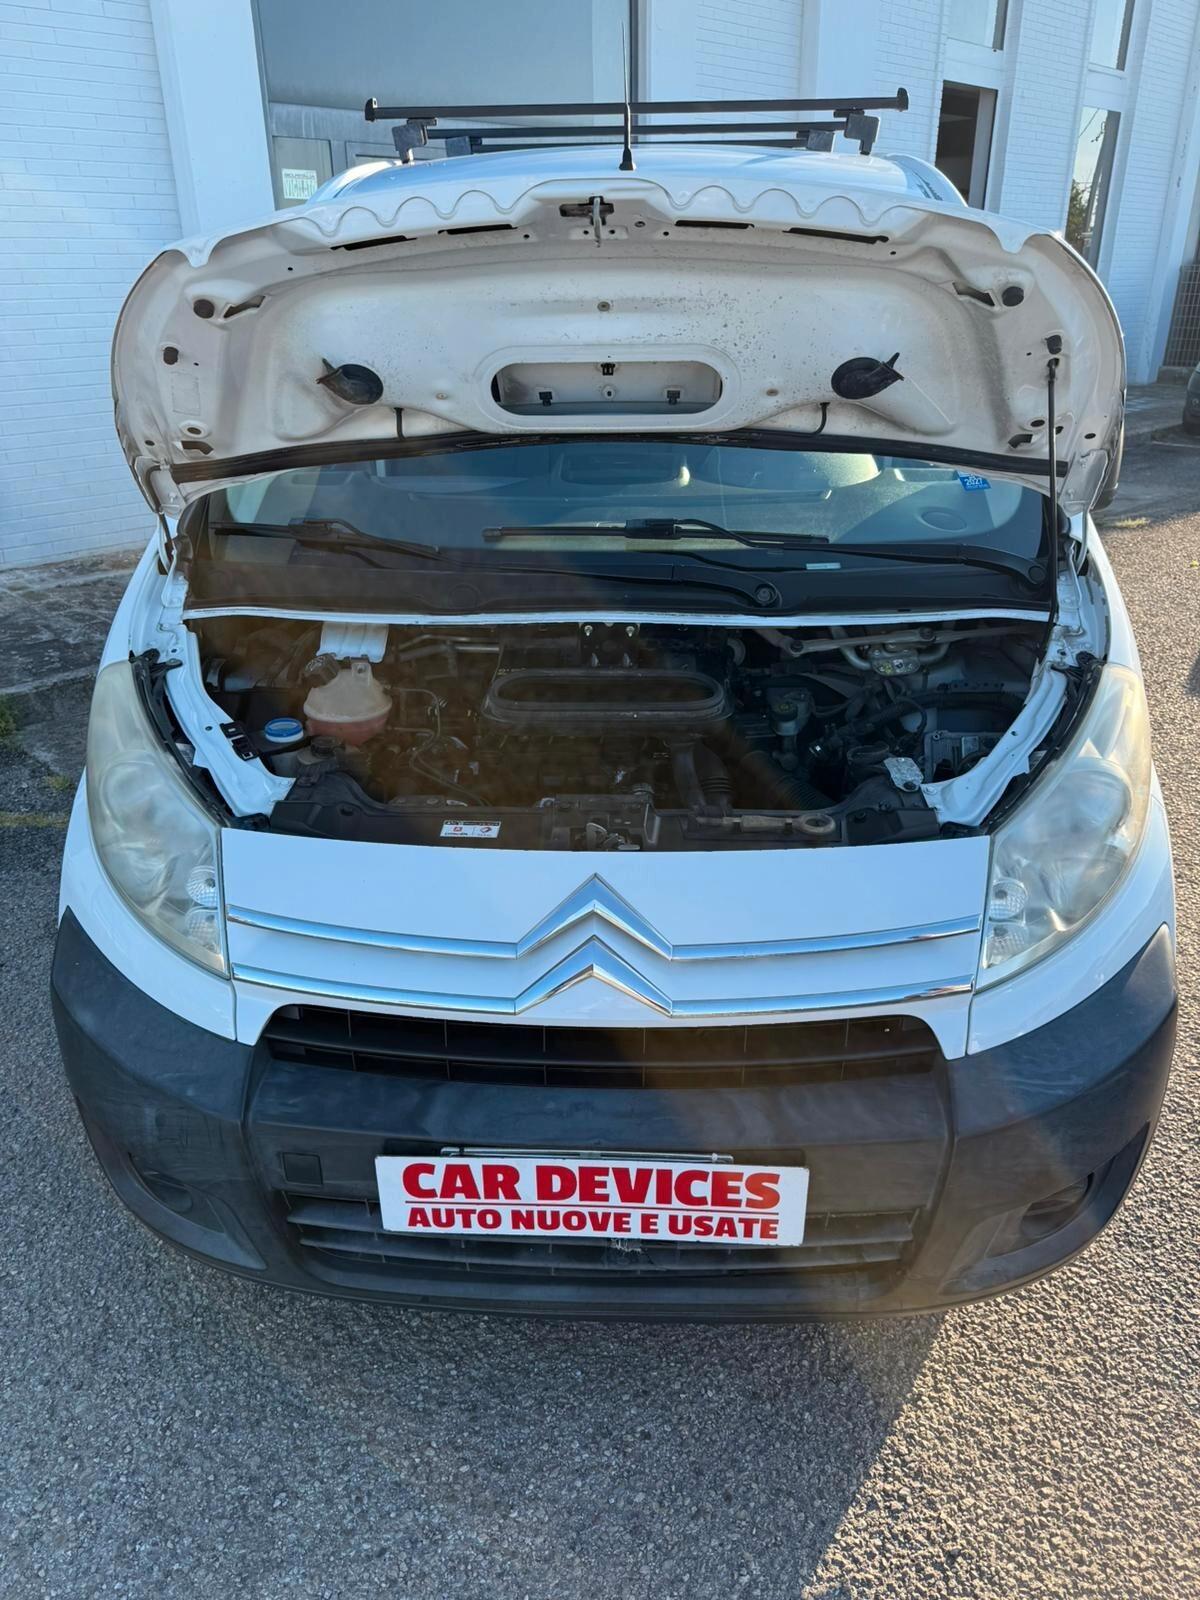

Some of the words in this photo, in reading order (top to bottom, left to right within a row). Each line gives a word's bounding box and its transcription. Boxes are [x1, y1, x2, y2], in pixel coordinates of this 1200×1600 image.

[401, 1163, 521, 1202] CAR
[535, 1164, 781, 1211] DEVICES
[407, 1207, 502, 1230] AUTO
[510, 1210, 631, 1234] NUOVE
[639, 1213, 659, 1234] E
[667, 1215, 779, 1241] USATE
